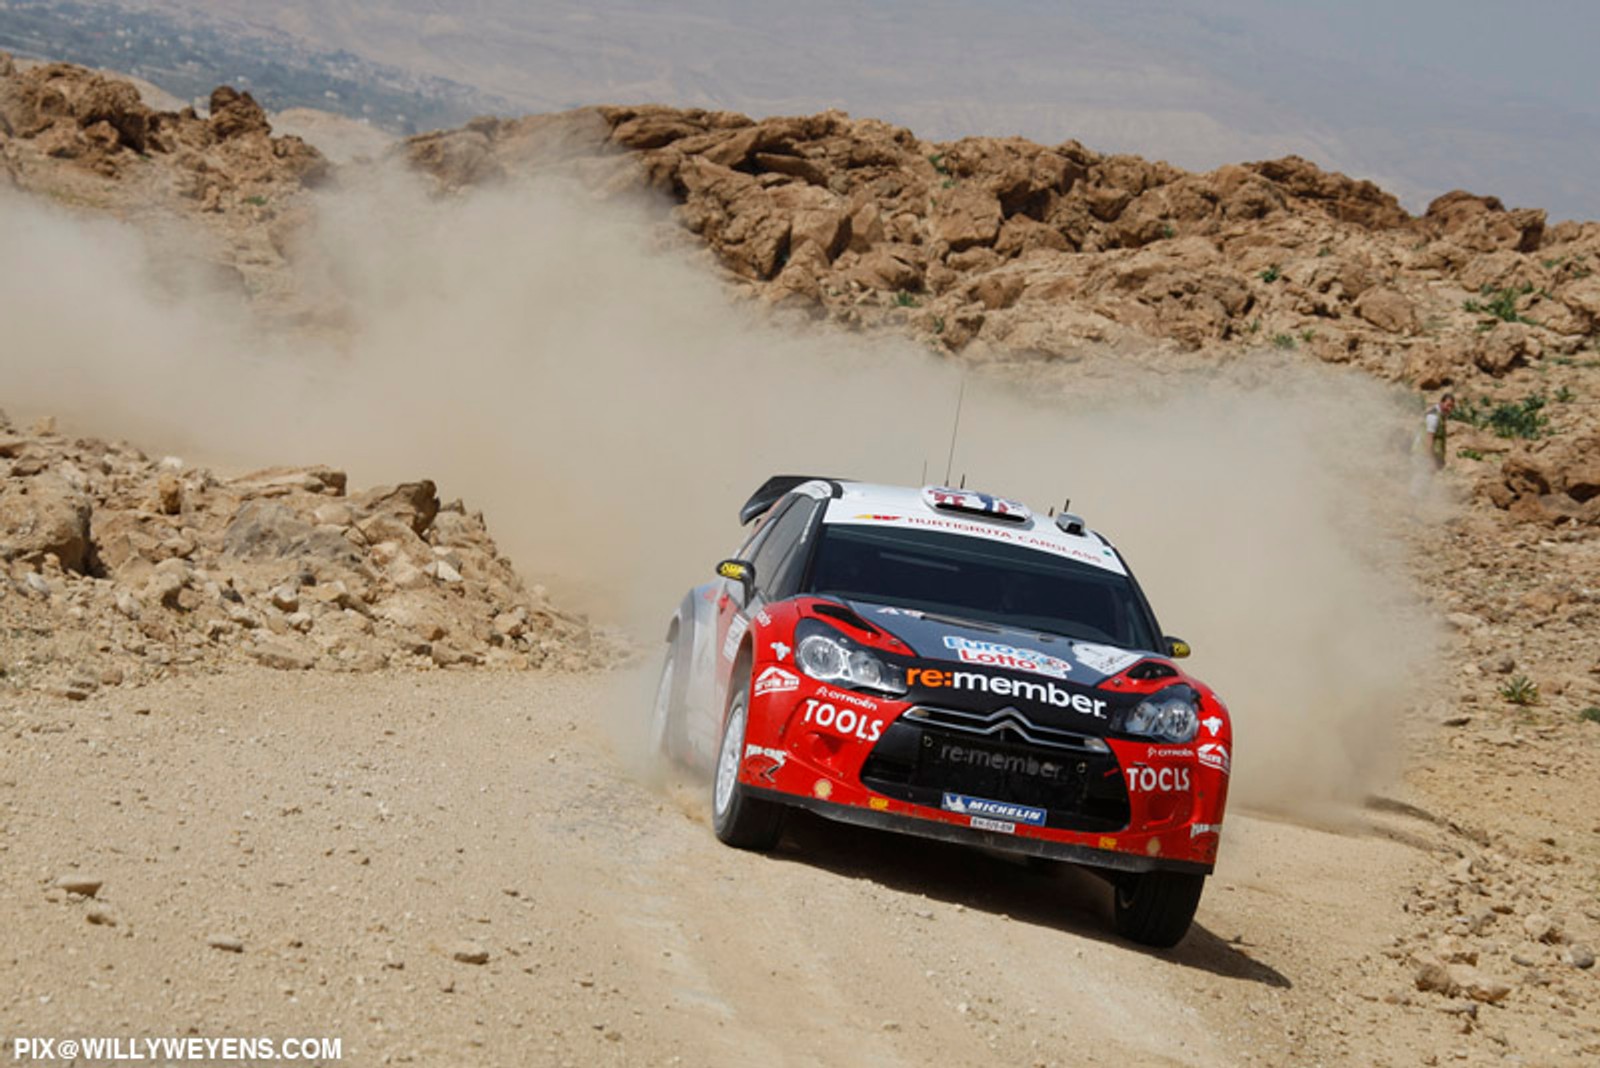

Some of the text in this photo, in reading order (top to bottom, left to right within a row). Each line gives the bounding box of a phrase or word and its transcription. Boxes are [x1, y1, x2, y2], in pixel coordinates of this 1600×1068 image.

[907, 516, 1013, 541] HURTIGRUTA
[961, 649, 1037, 670] Lotto
[804, 698, 884, 742] TOOLS
[968, 800, 1042, 821] MICHELIN
